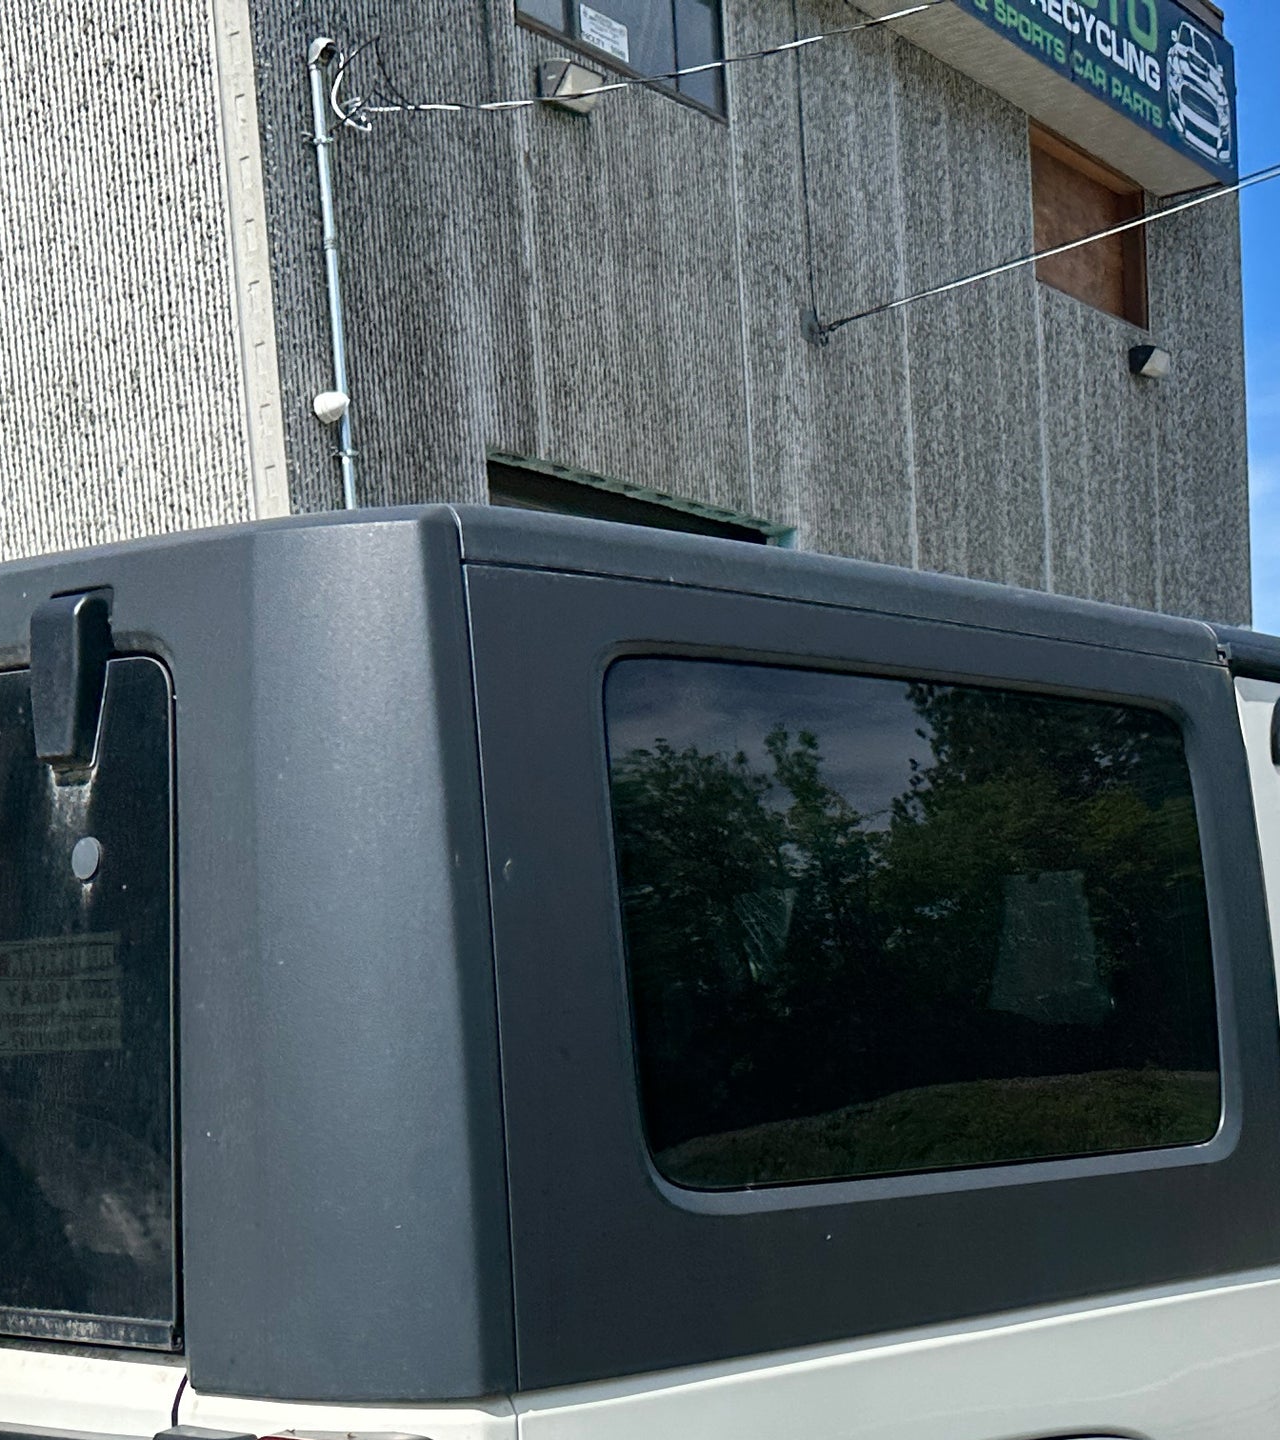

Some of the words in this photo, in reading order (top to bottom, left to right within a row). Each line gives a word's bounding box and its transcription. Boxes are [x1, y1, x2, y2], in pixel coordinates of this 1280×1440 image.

[994, 0, 1066, 64] SPORTS
[1071, 49, 1107, 93] CAR
[1111, 76, 1163, 129] PARTS
